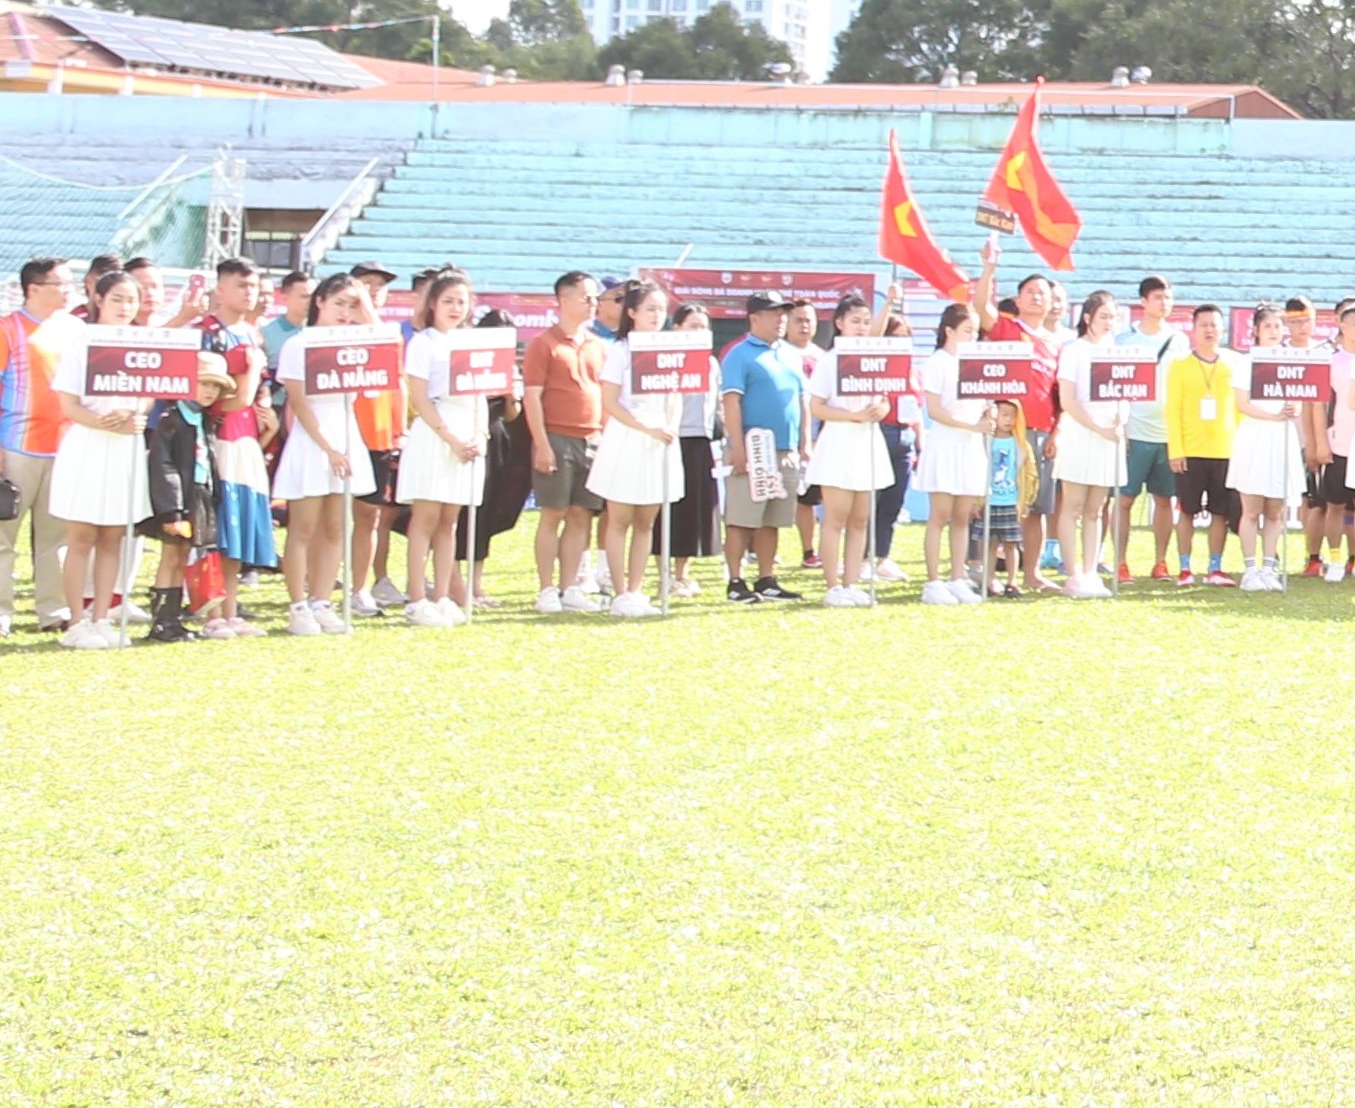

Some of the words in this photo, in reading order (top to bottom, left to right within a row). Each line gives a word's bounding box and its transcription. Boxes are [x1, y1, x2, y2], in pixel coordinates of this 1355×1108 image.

[125, 351, 161, 368] CEO
[337, 348, 368, 365] CEO
[657, 353, 686, 368] DNT
[860, 357, 887, 372] DNT
[317, 370, 340, 389] ĐÀ
[343, 366, 388, 387] NẴNG
[983, 364, 1006, 377] CEO
[1112, 365, 1135, 378] DNT
[1277, 366, 1305, 379] DNT
[94, 371, 142, 392] MIỀN
[145, 376, 189, 393] NAM
[641, 371, 679, 392] NGHỆ
[680, 373, 701, 388] AN
[841, 375, 872, 391] BÌNH
[874, 378, 906, 395] ĐỊNH
[960, 379, 1001, 394] KHÁNH
[1002, 379, 1026, 394] HÒA
[1263, 381, 1283, 397] HÀ
[1286, 384, 1317, 397] NAM
